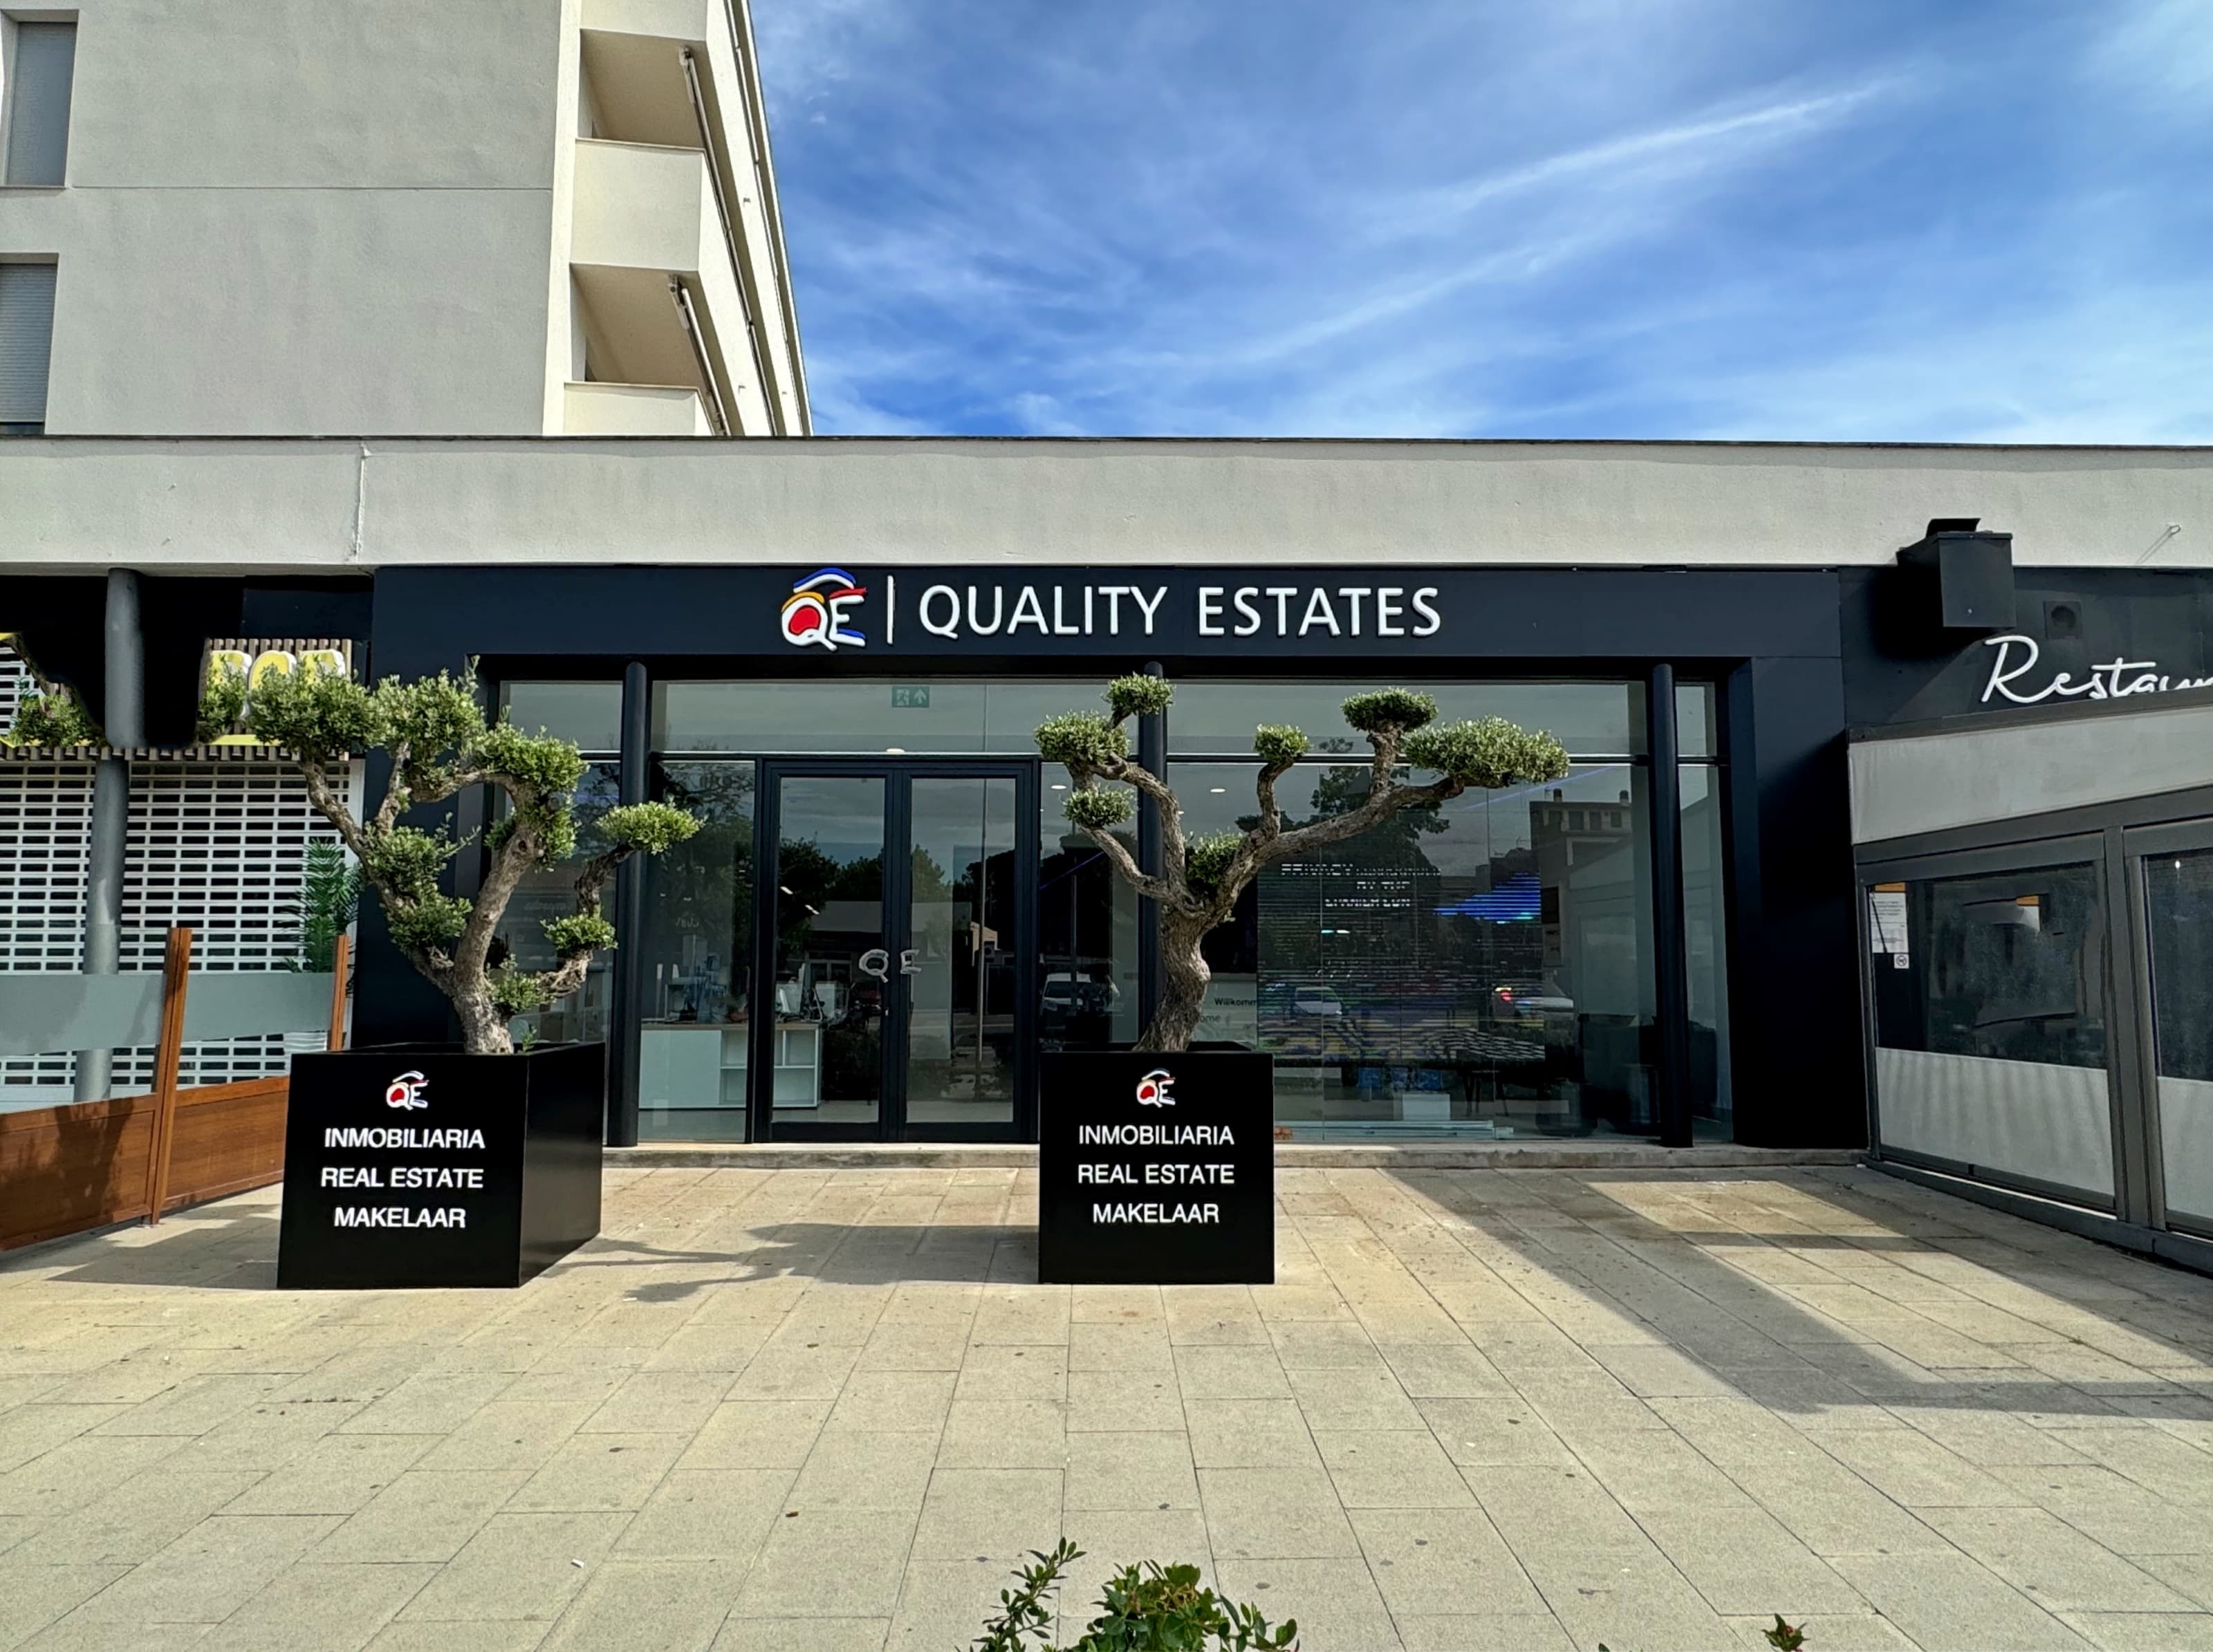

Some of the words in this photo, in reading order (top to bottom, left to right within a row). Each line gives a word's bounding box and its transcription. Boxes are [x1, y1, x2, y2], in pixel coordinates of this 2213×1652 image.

[781, 588, 867, 651] QE
[919, 585, 1167, 639] QUALITY
[1199, 587, 1441, 636] ESTATES
[1214, 998, 1257, 1006] Willkomm
[324, 1127, 485, 1149] INMOBILIARIA
[1079, 1124, 1234, 1145] INMOBILIARIA
[321, 1167, 385, 1187] REAL
[390, 1167, 484, 1188] ESTATE
[1078, 1164, 1138, 1183] REAL
[1145, 1164, 1234, 1184] ESTATE
[334, 1207, 466, 1228] MAKELAAR
[1093, 1203, 1219, 1223] MAKELAAR
